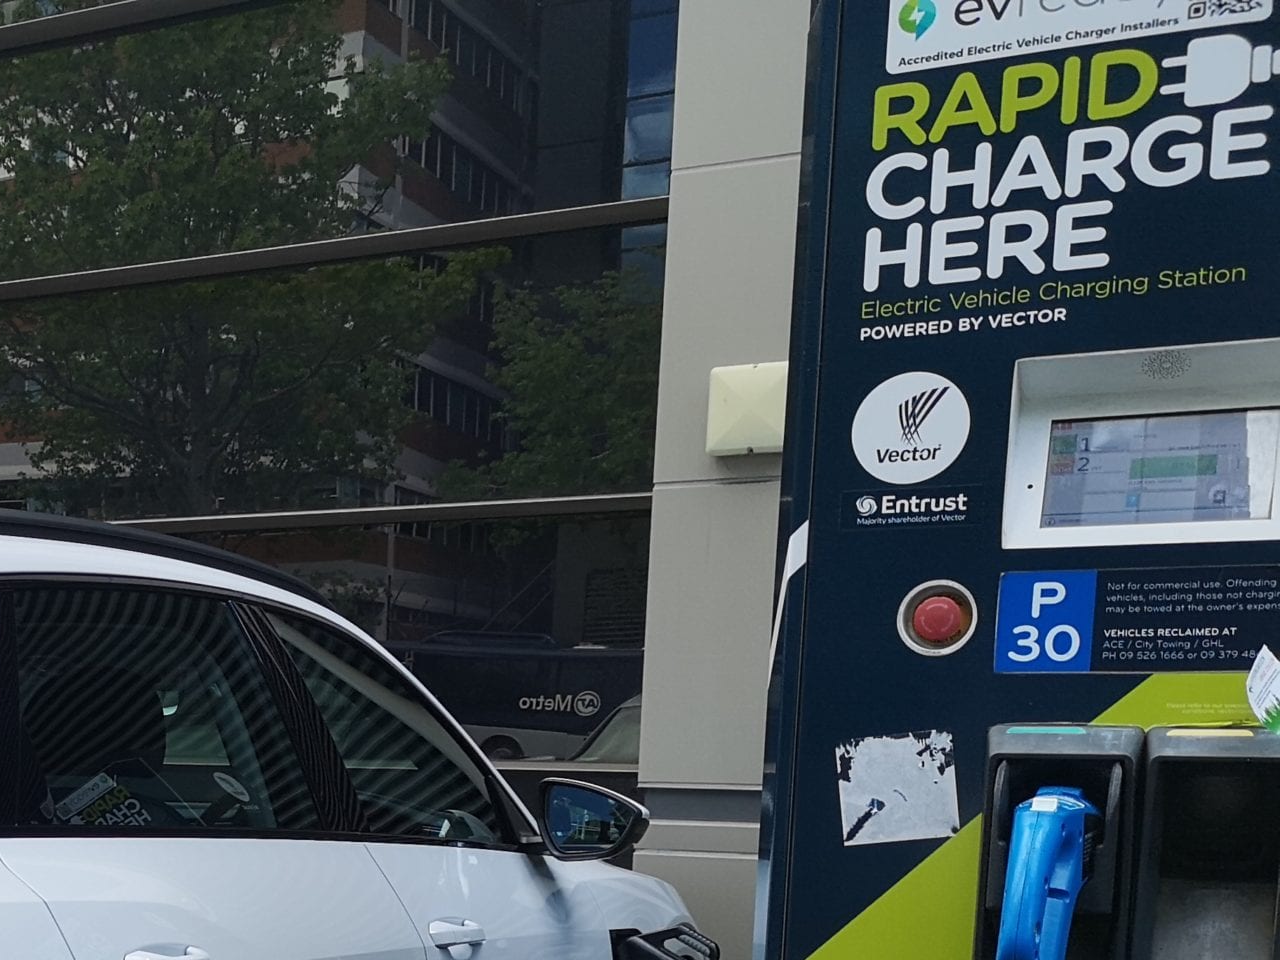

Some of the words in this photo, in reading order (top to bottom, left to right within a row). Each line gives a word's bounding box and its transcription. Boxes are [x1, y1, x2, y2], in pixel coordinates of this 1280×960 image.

[898, 48, 964, 67] Accredited
[967, 41, 1013, 56] Electric
[1016, 33, 1062, 48] Vehicle
[1065, 25, 1116, 42] Charger
[1120, 16, 1180, 33] Installers
[872, 49, 1158, 151] RAPID
[865, 104, 1274, 220] CHARGE
[863, 200, 1113, 292] HERE
[860, 293, 941, 319] Electric
[949, 286, 1030, 310] Vehicle
[1039, 274, 1149, 301] Charging
[1157, 265, 1247, 289] Station
[859, 319, 952, 341] POWERED
[958, 315, 984, 332] BY
[988, 307, 1067, 328] VECTOR
[1081, 437, 1090, 452] 1
[876, 445, 941, 464] Vector
[1077, 456, 1090, 472] 2
[881, 493, 968, 514] Entrust
[856, 516, 887, 526] Majority
[888, 514, 931, 525] shareholder
[931, 514, 940, 523] of
[941, 513, 966, 523] Vector
[1107, 582, 1125, 591] Not
[1127, 581, 1141, 591] for
[1143, 580, 1200, 591] commercial
[1202, 581, 1223, 590] use.
[1226, 578, 1277, 588] Offending
[1031, 582, 1067, 619] P
[1106, 593, 1146, 603] vehicles,
[1148, 592, 1193, 603] including
[1196, 592, 1223, 600] those
[1226, 591, 1243, 599] not
[1105, 605, 1125, 614] may
[1128, 604, 1141, 613] be
[1143, 604, 1172, 612] towed
[1175, 604, 1185, 612] at
[1187, 603, 1203, 612] the
[1206, 603, 1244, 611] owner's
[1103, 628, 1155, 638] VEHICLES
[1157, 627, 1219, 637] RECLAIMED
[1221, 627, 1238, 636] AT
[1007, 624, 1081, 662] 30
[1102, 640, 1125, 649] ACE
[1135, 639, 1154, 650] City
[1156, 639, 1191, 650] Towing
[1201, 638, 1224, 648] GHL
[1102, 651, 1117, 660] PH
[1119, 651, 1134, 660] 09
[1136, 651, 1157, 660] 526
[1160, 650, 1185, 659] 1666
[1187, 651, 1198, 659] or
[1200, 650, 1215, 659] 09
[1217, 650, 1238, 658] 379
